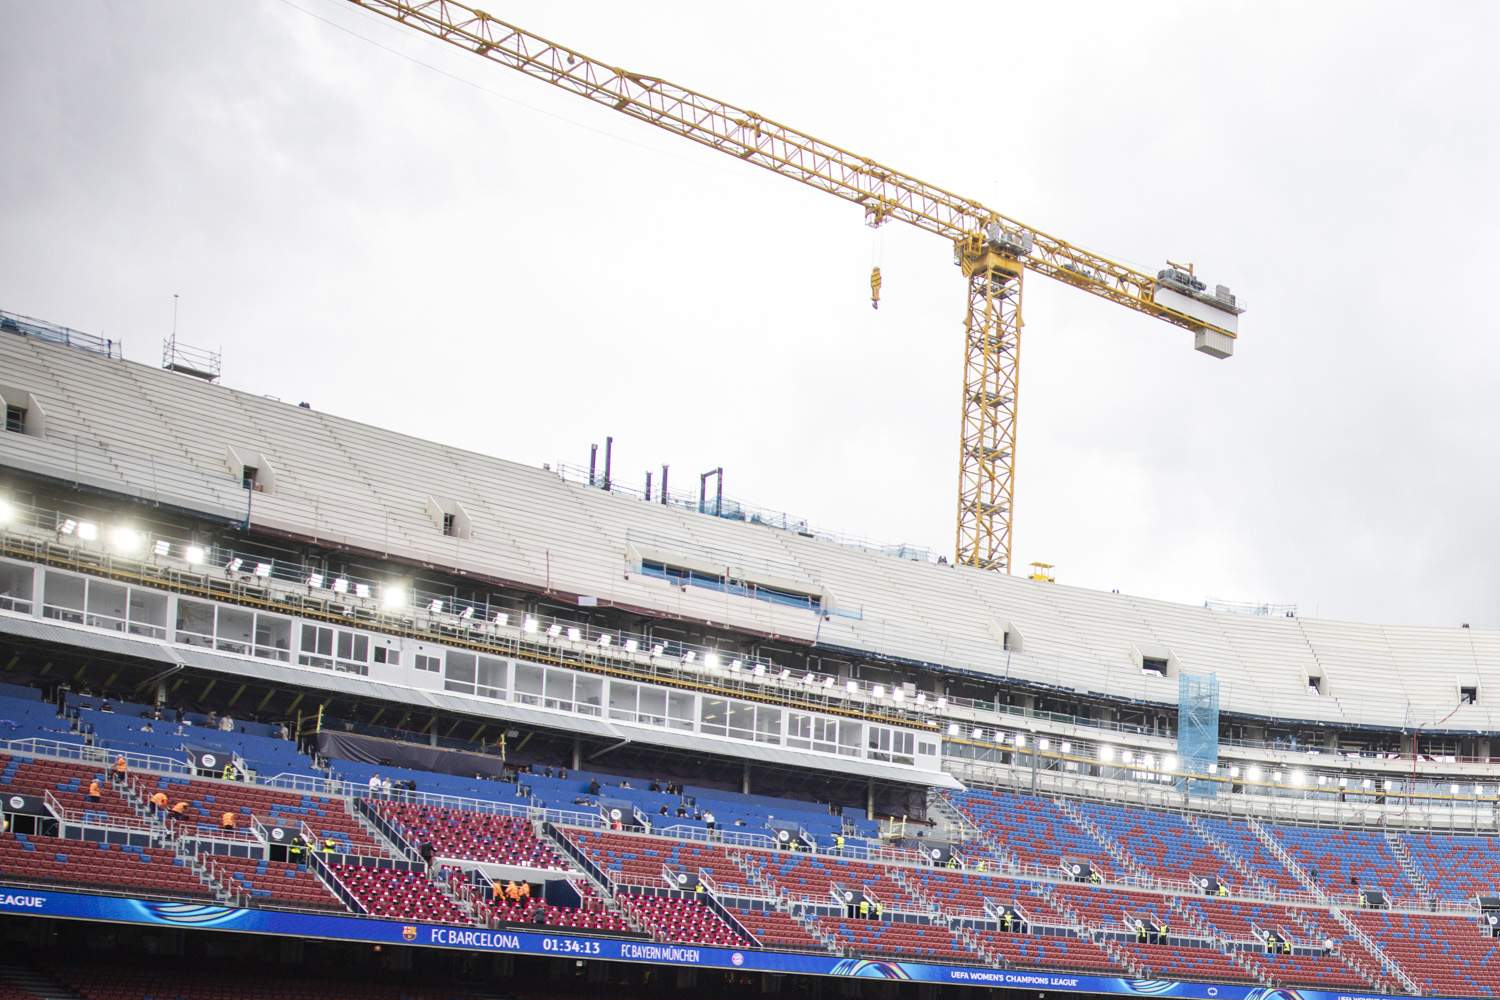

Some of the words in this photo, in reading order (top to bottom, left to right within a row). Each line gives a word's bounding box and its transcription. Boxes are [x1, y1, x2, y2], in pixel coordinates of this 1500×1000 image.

[431, 928, 447, 944] FC
[449, 930, 520, 949] BARCELONA
[543, 938, 600, 954] 01:34:13
[621, 943, 632, 958] FC
[632, 945, 661, 960] BAYERN
[662, 945, 700, 962] MÜNCHEN
[951, 971, 969, 979] UEFA
[970, 972, 1004, 982] WOMEN'S
[1006, 975, 1049, 985] CHAMPIONS
[1050, 978, 1077, 986] LEAGUE
